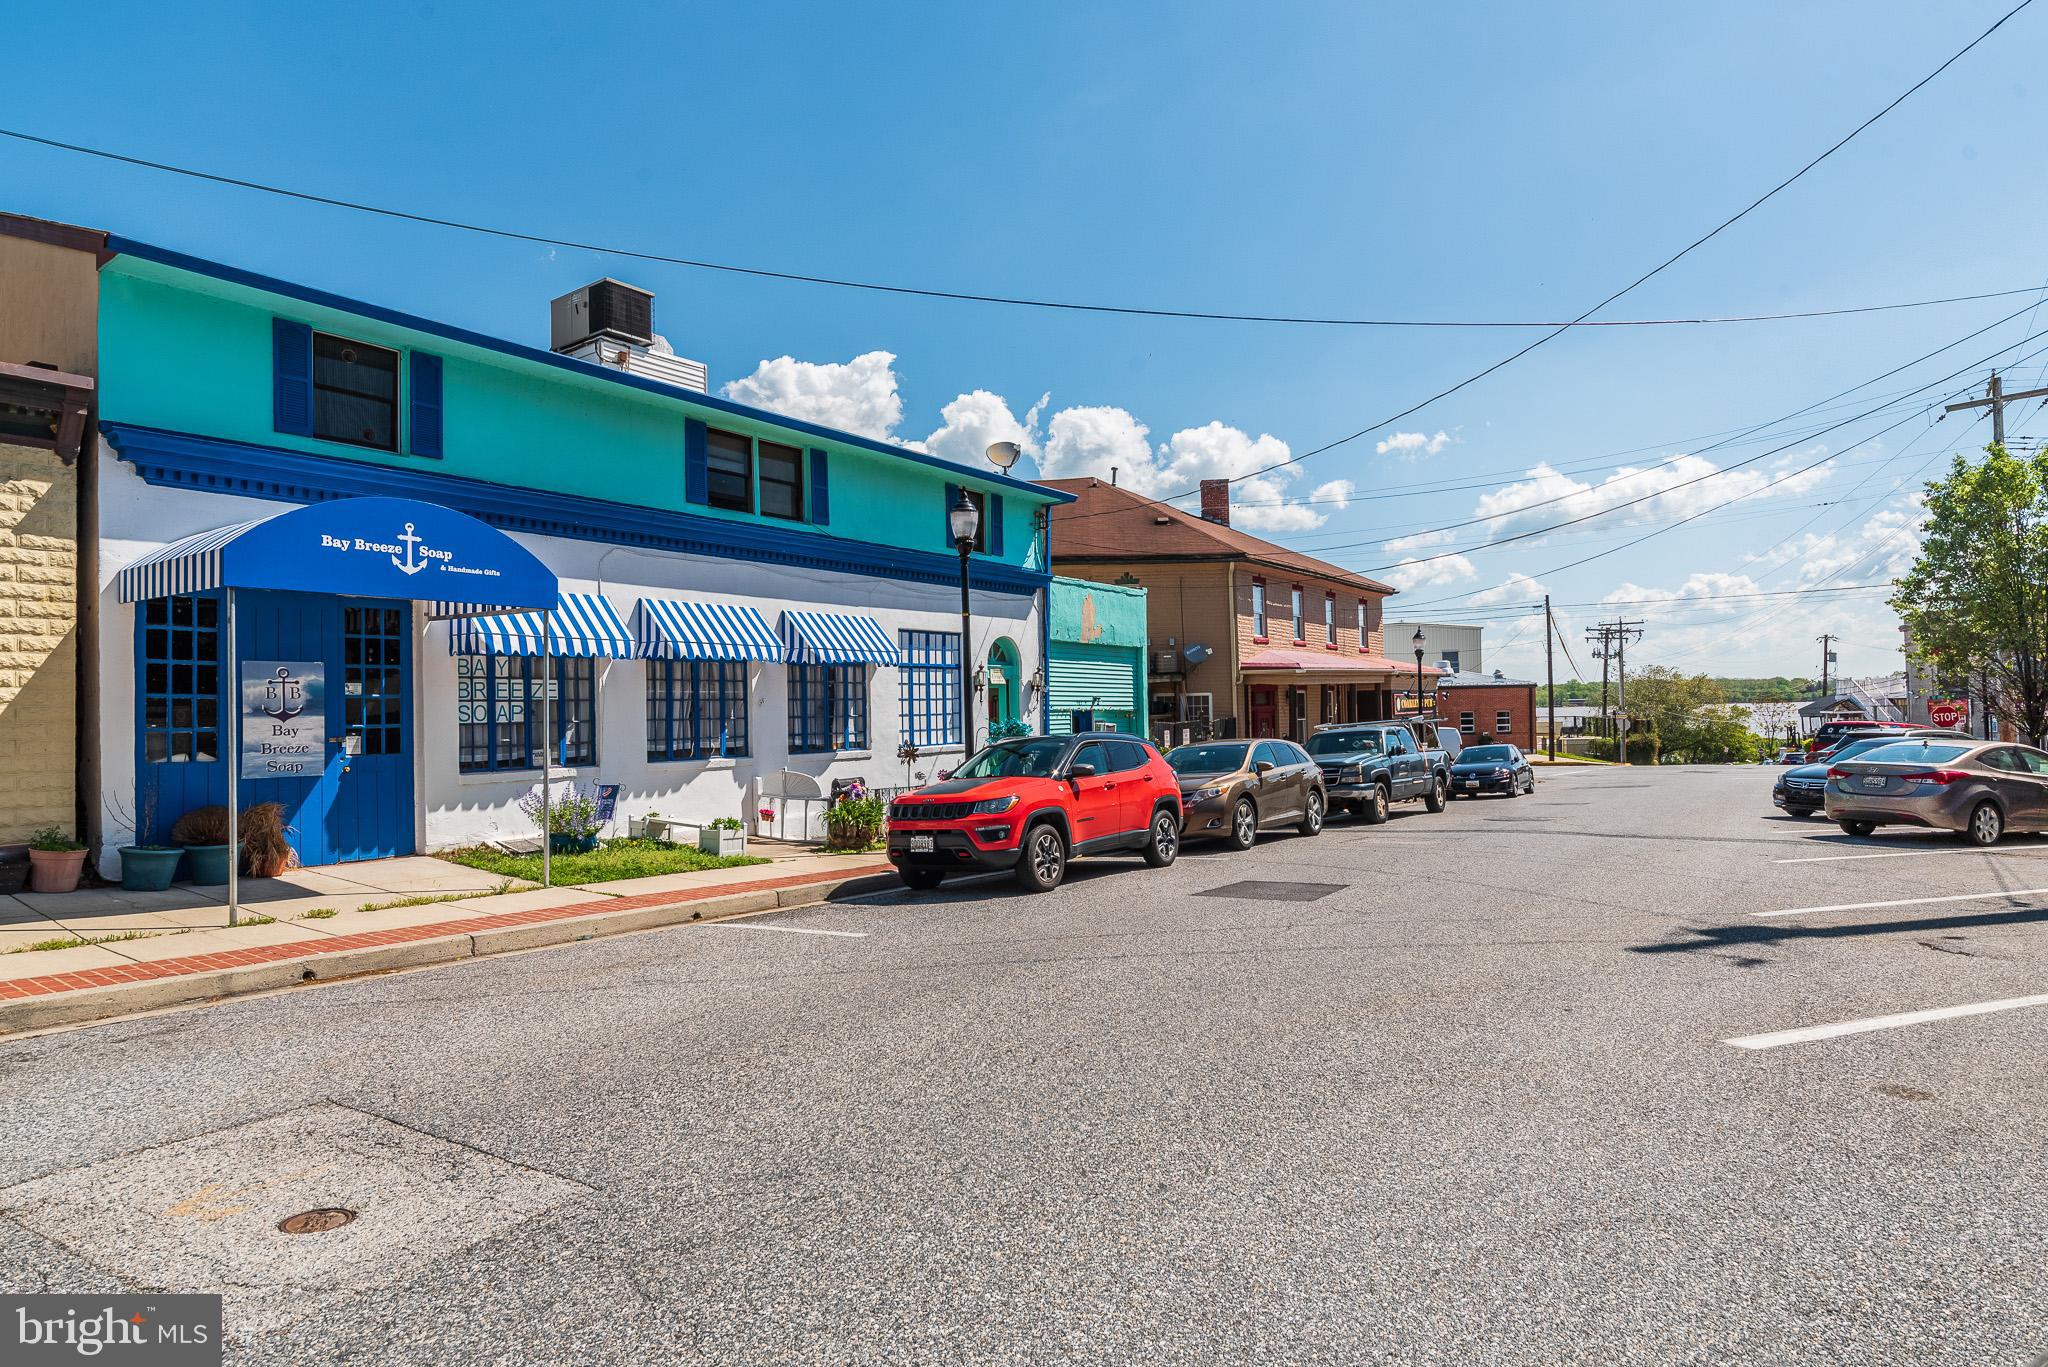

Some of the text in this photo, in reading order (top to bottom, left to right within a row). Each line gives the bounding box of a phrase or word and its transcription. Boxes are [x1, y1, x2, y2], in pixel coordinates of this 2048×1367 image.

[321, 534, 453, 562] Bay Breeze Soap
[448, 565, 483, 575] Handmade
[483, 568, 501, 577] Gifts
[458, 658, 508, 675] BAY
[265, 686, 302, 700] B B
[458, 682, 558, 699] BREEZE
[458, 704, 524, 722] SOAP
[1933, 712, 1958, 722] STOP
[272, 725, 300, 739] Bay
[261, 743, 310, 755] Breeze
[266, 760, 304, 774] Soap
